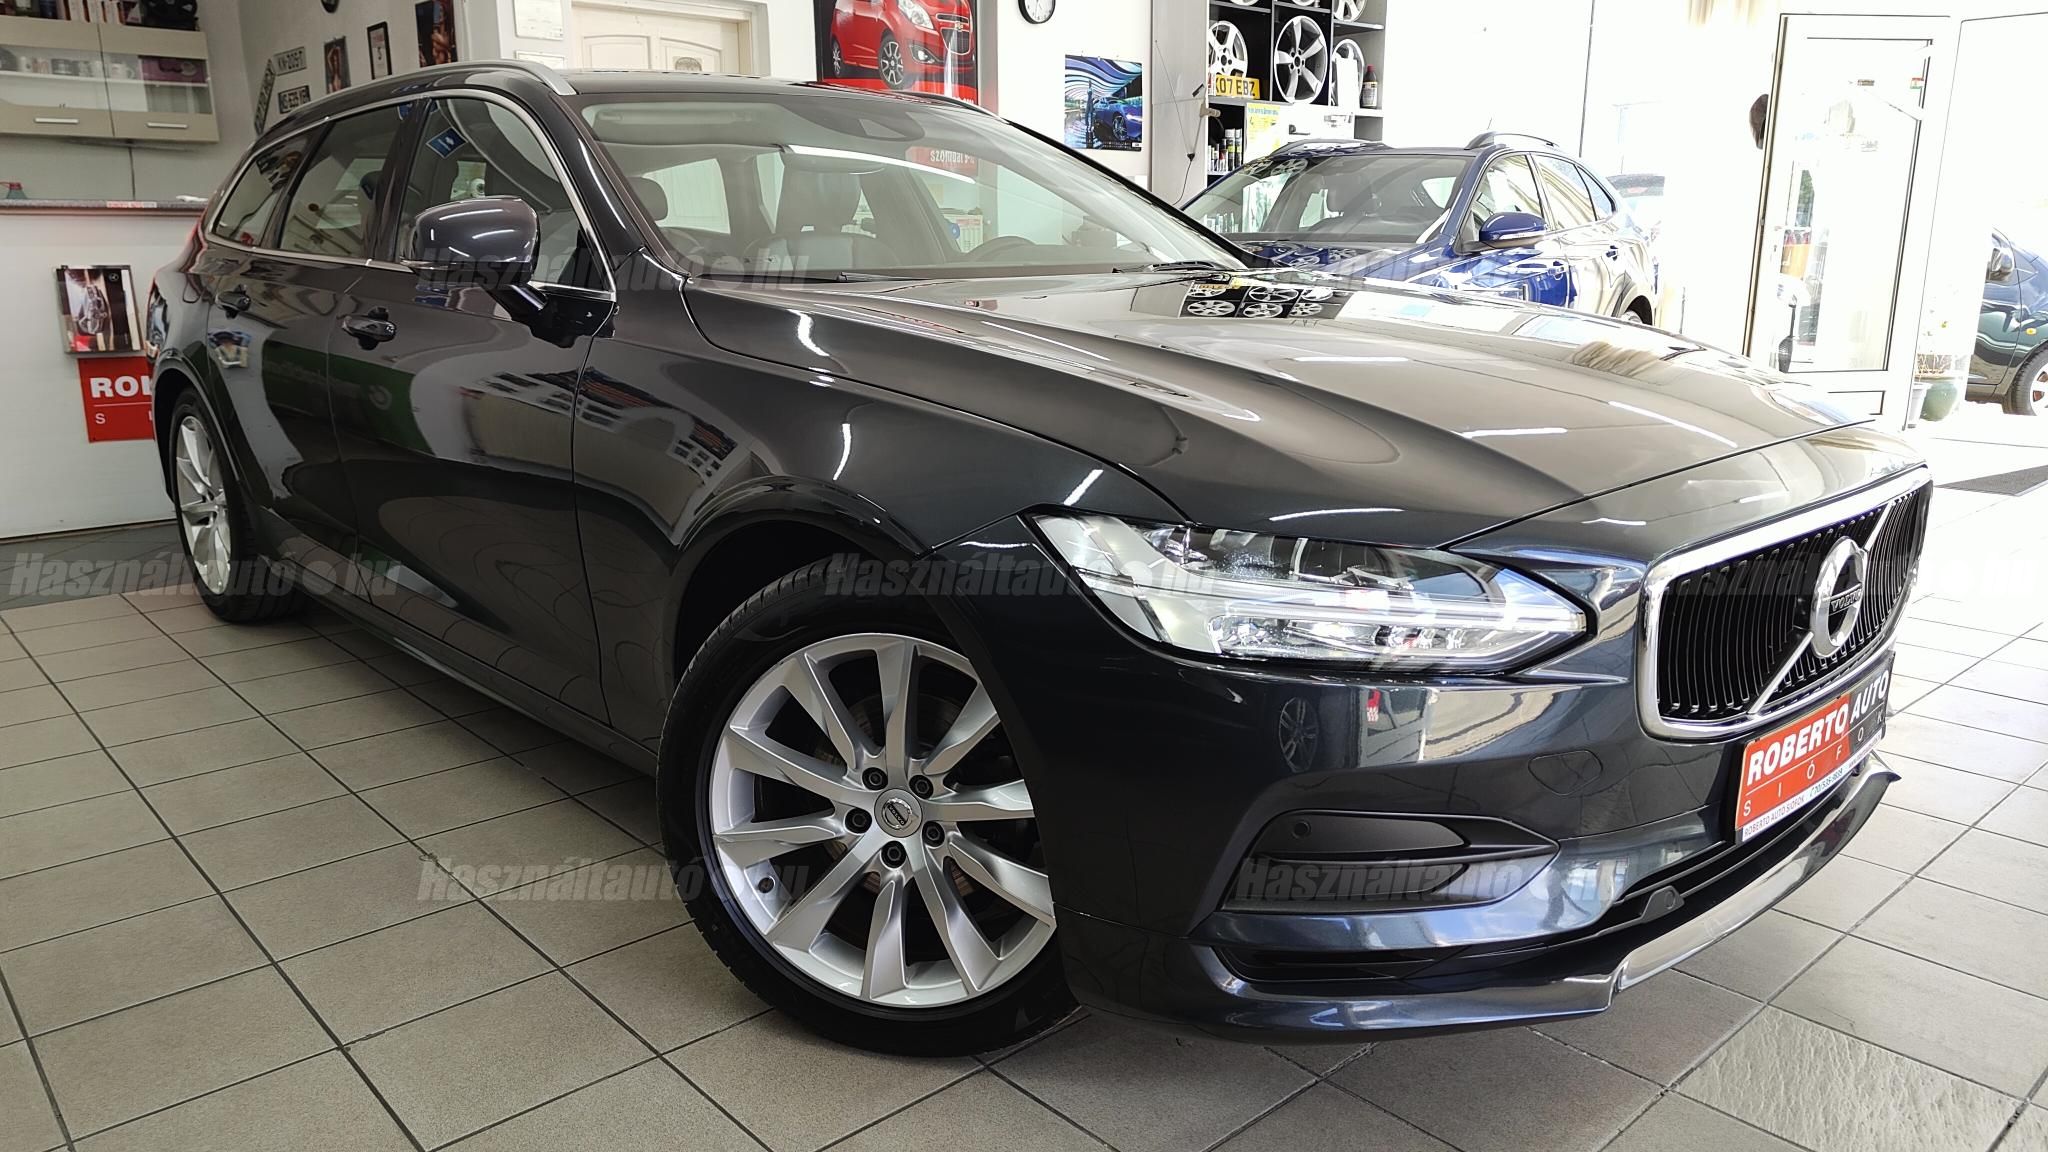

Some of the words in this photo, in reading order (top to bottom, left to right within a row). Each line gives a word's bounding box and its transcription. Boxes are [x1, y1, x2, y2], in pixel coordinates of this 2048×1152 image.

[1236, 80, 1256, 97] EBZ
[1830, 589, 1862, 612] VOLVO
[1747, 703, 1849, 786] ROBERTO
[1850, 670, 1889, 724] AUTO
[887, 804, 906, 826] VOLVO
